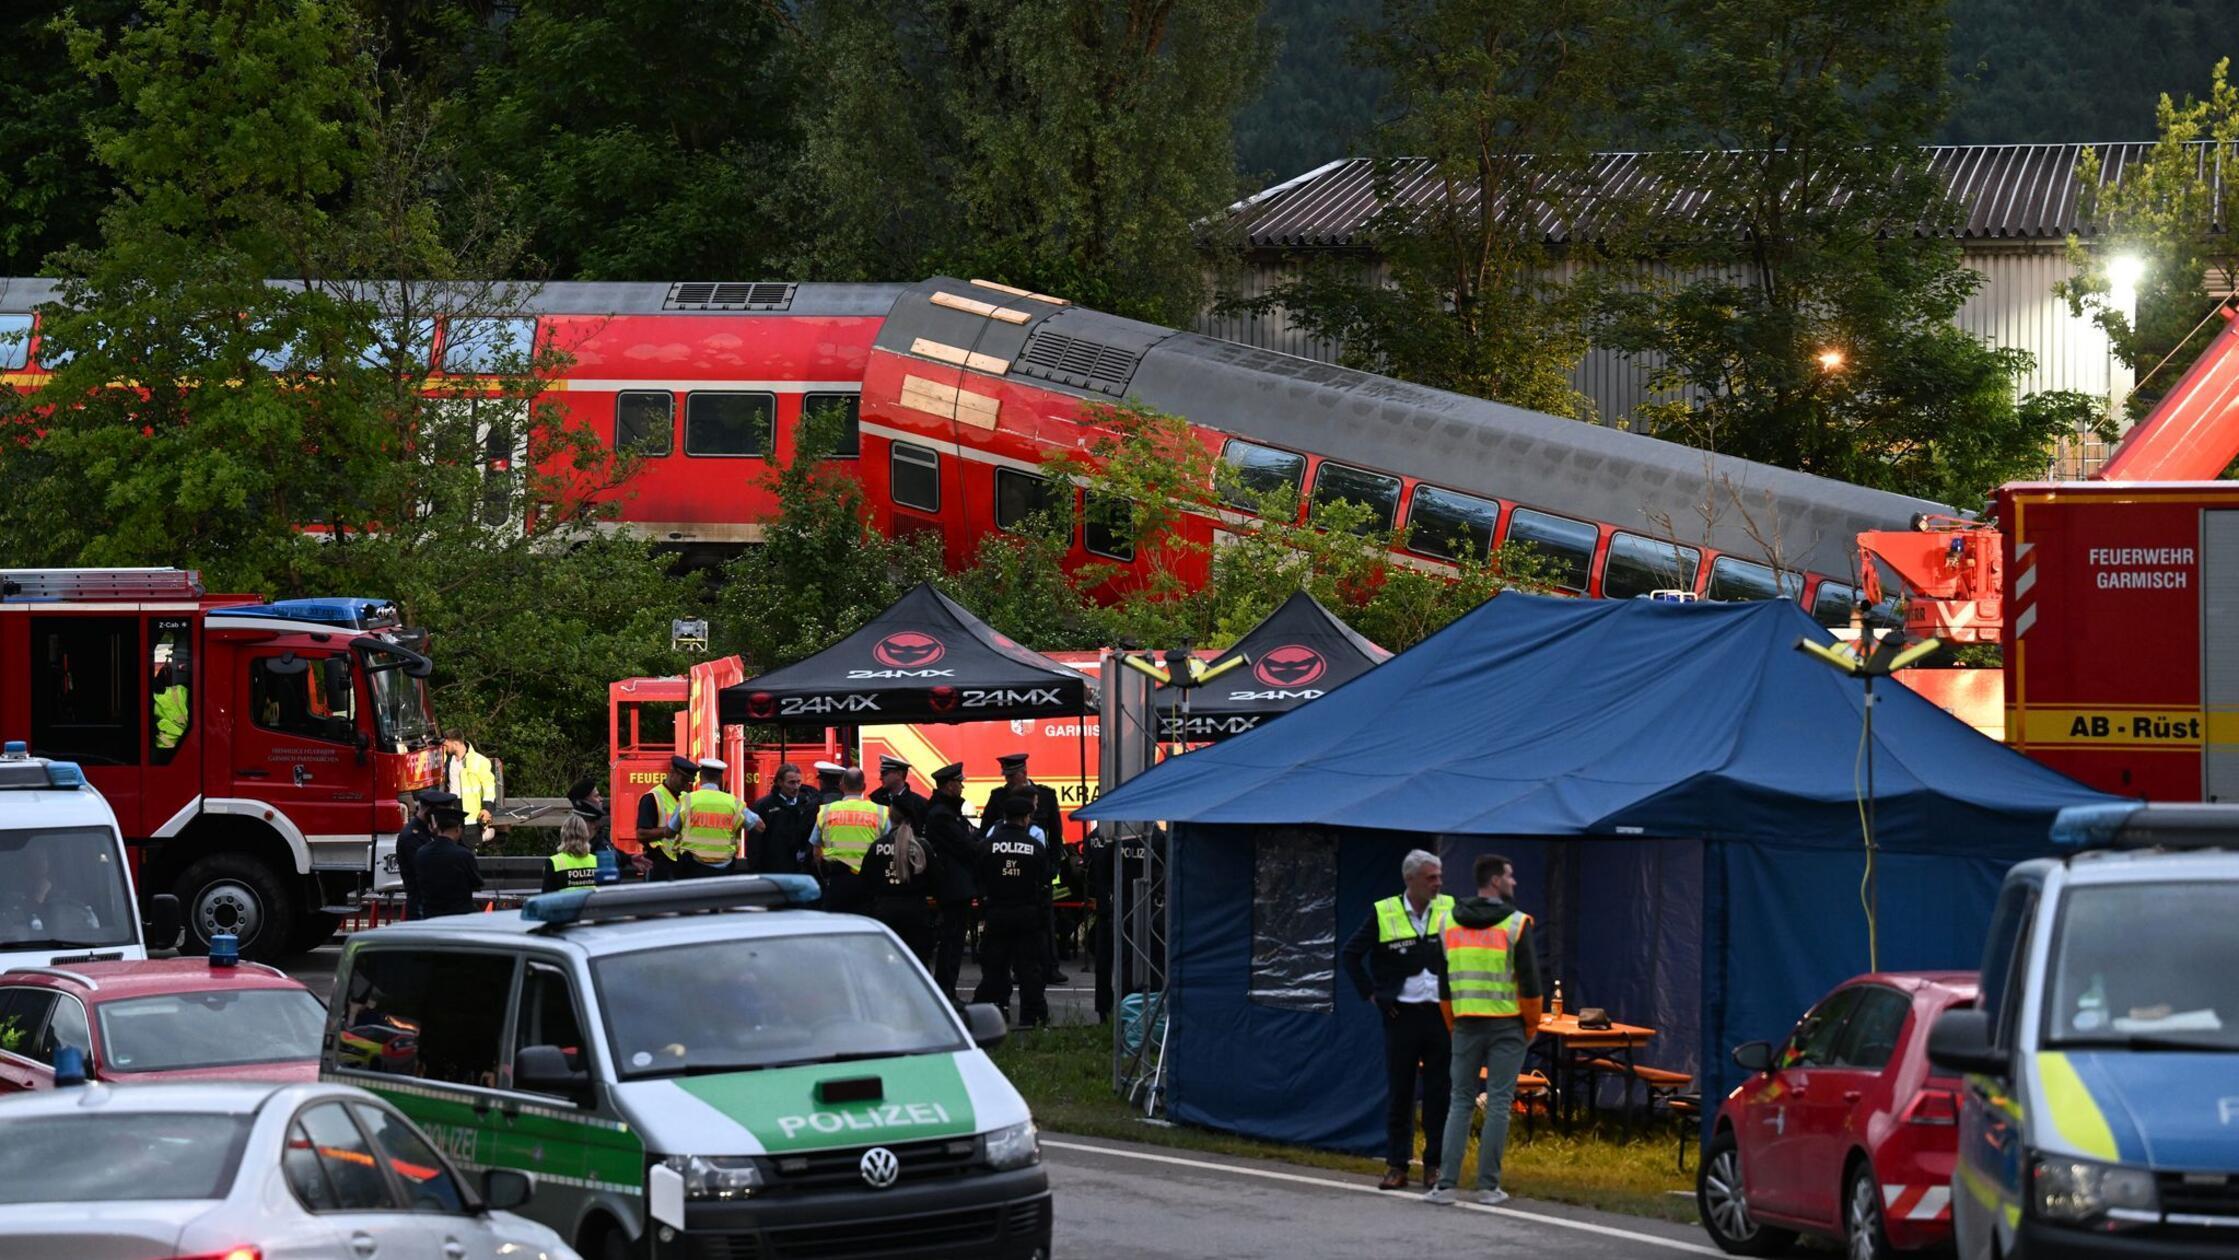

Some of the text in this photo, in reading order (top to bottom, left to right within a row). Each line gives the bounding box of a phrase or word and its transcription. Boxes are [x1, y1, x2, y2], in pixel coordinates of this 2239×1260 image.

[2089, 548, 2194, 565] FEUERWEHR
[2096, 572, 2187, 589] GARMISCH
[846, 668, 956, 680] 24MX
[780, 693, 882, 715] 24MX
[962, 688, 1063, 708] 24MX
[1045, 725, 1100, 737] GARMIS
[1160, 716, 1260, 735] 24MX
[2069, 716, 2110, 737] AB
[2132, 716, 2200, 739] Rüst
[629, 773, 668, 784] FEUER
[992, 842, 1034, 855] POLIZEI
[1002, 868, 1021, 876] 5411
[1005, 860, 1017, 868] BY
[777, 1102, 951, 1139] POLIZEI
